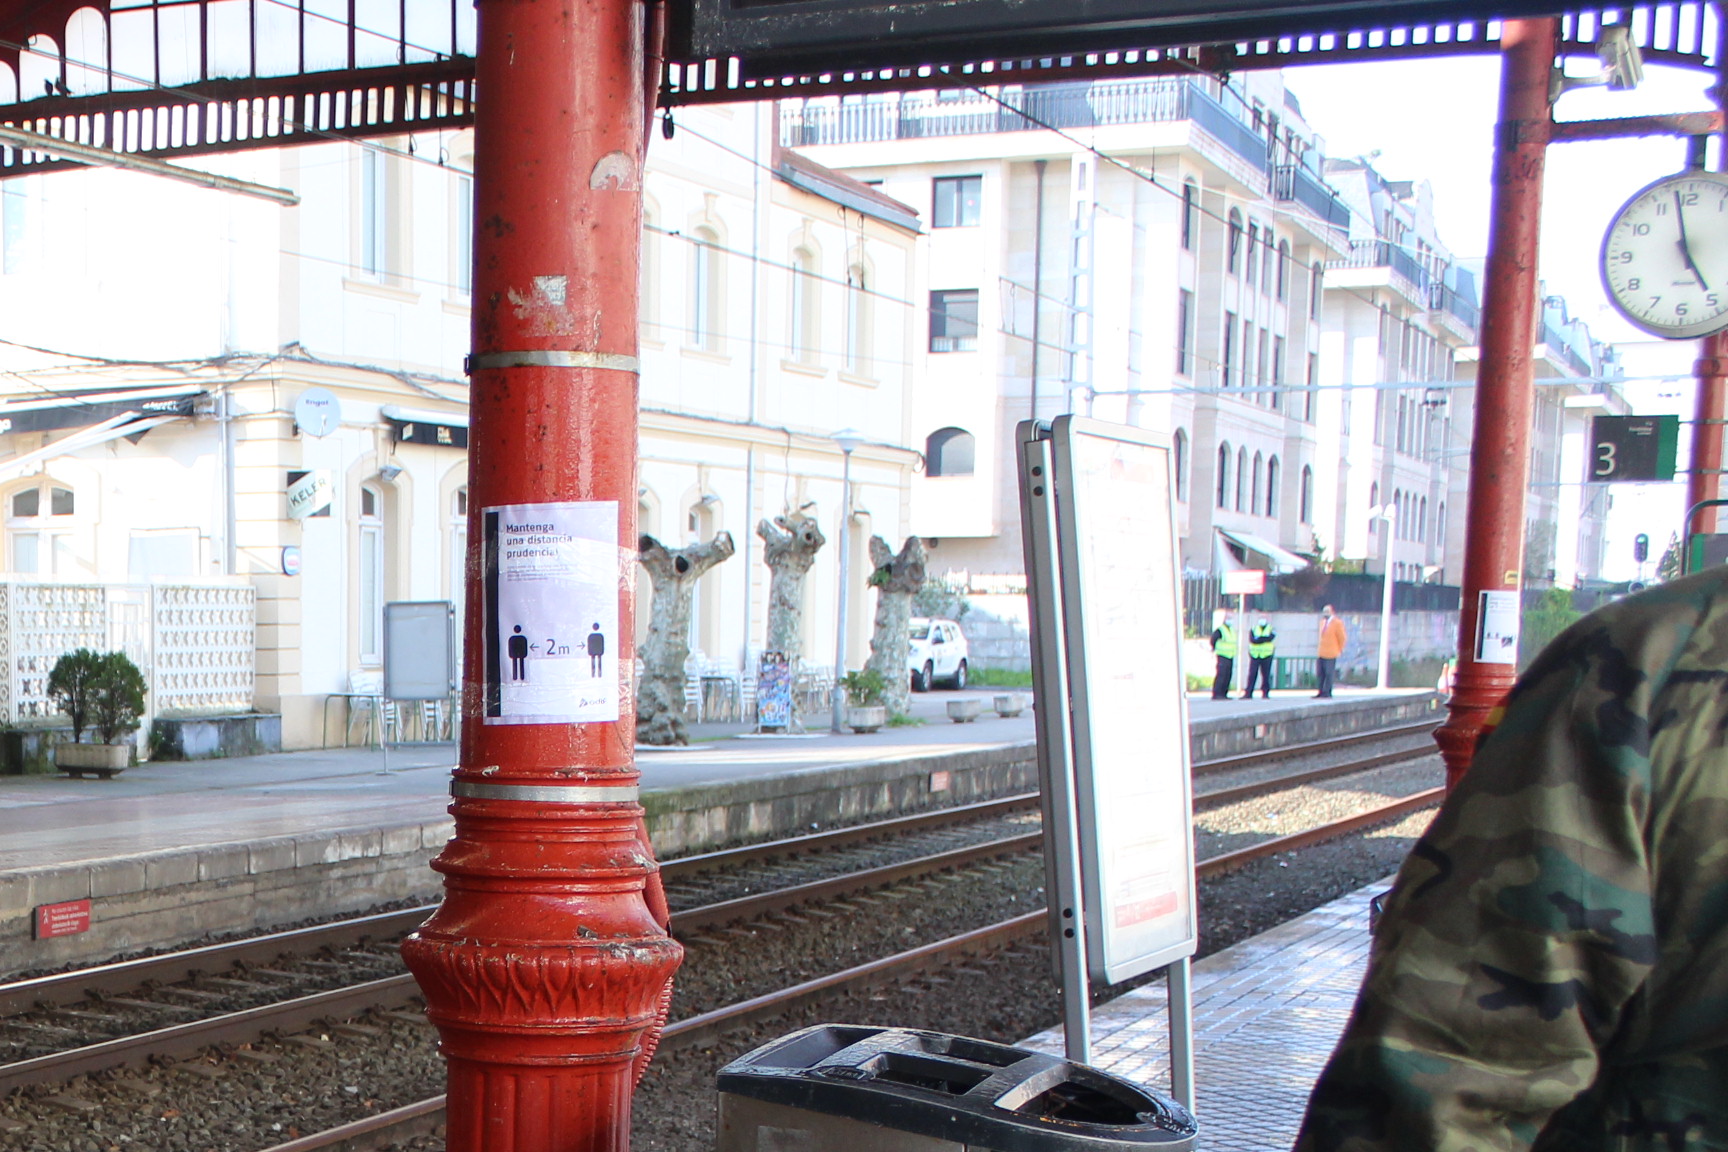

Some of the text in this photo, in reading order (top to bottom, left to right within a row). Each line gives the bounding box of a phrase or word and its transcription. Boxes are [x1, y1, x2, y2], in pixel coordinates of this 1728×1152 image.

[1656, 203, 1667, 216] 11
[1632, 223, 1650, 237] 10
[1620, 251, 1633, 264] 9
[1627, 278, 1640, 291] 8
[1649, 296, 1661, 309] 7
[1706, 293, 1718, 307] 5
[1675, 303, 1688, 316] 6
[1595, 442, 1617, 476] 3
[290, 477, 327, 507] KELER
[506, 523, 555, 534] Mantenga
[506, 534, 573, 546] una distancia
[506, 547, 559, 560] prudencial
